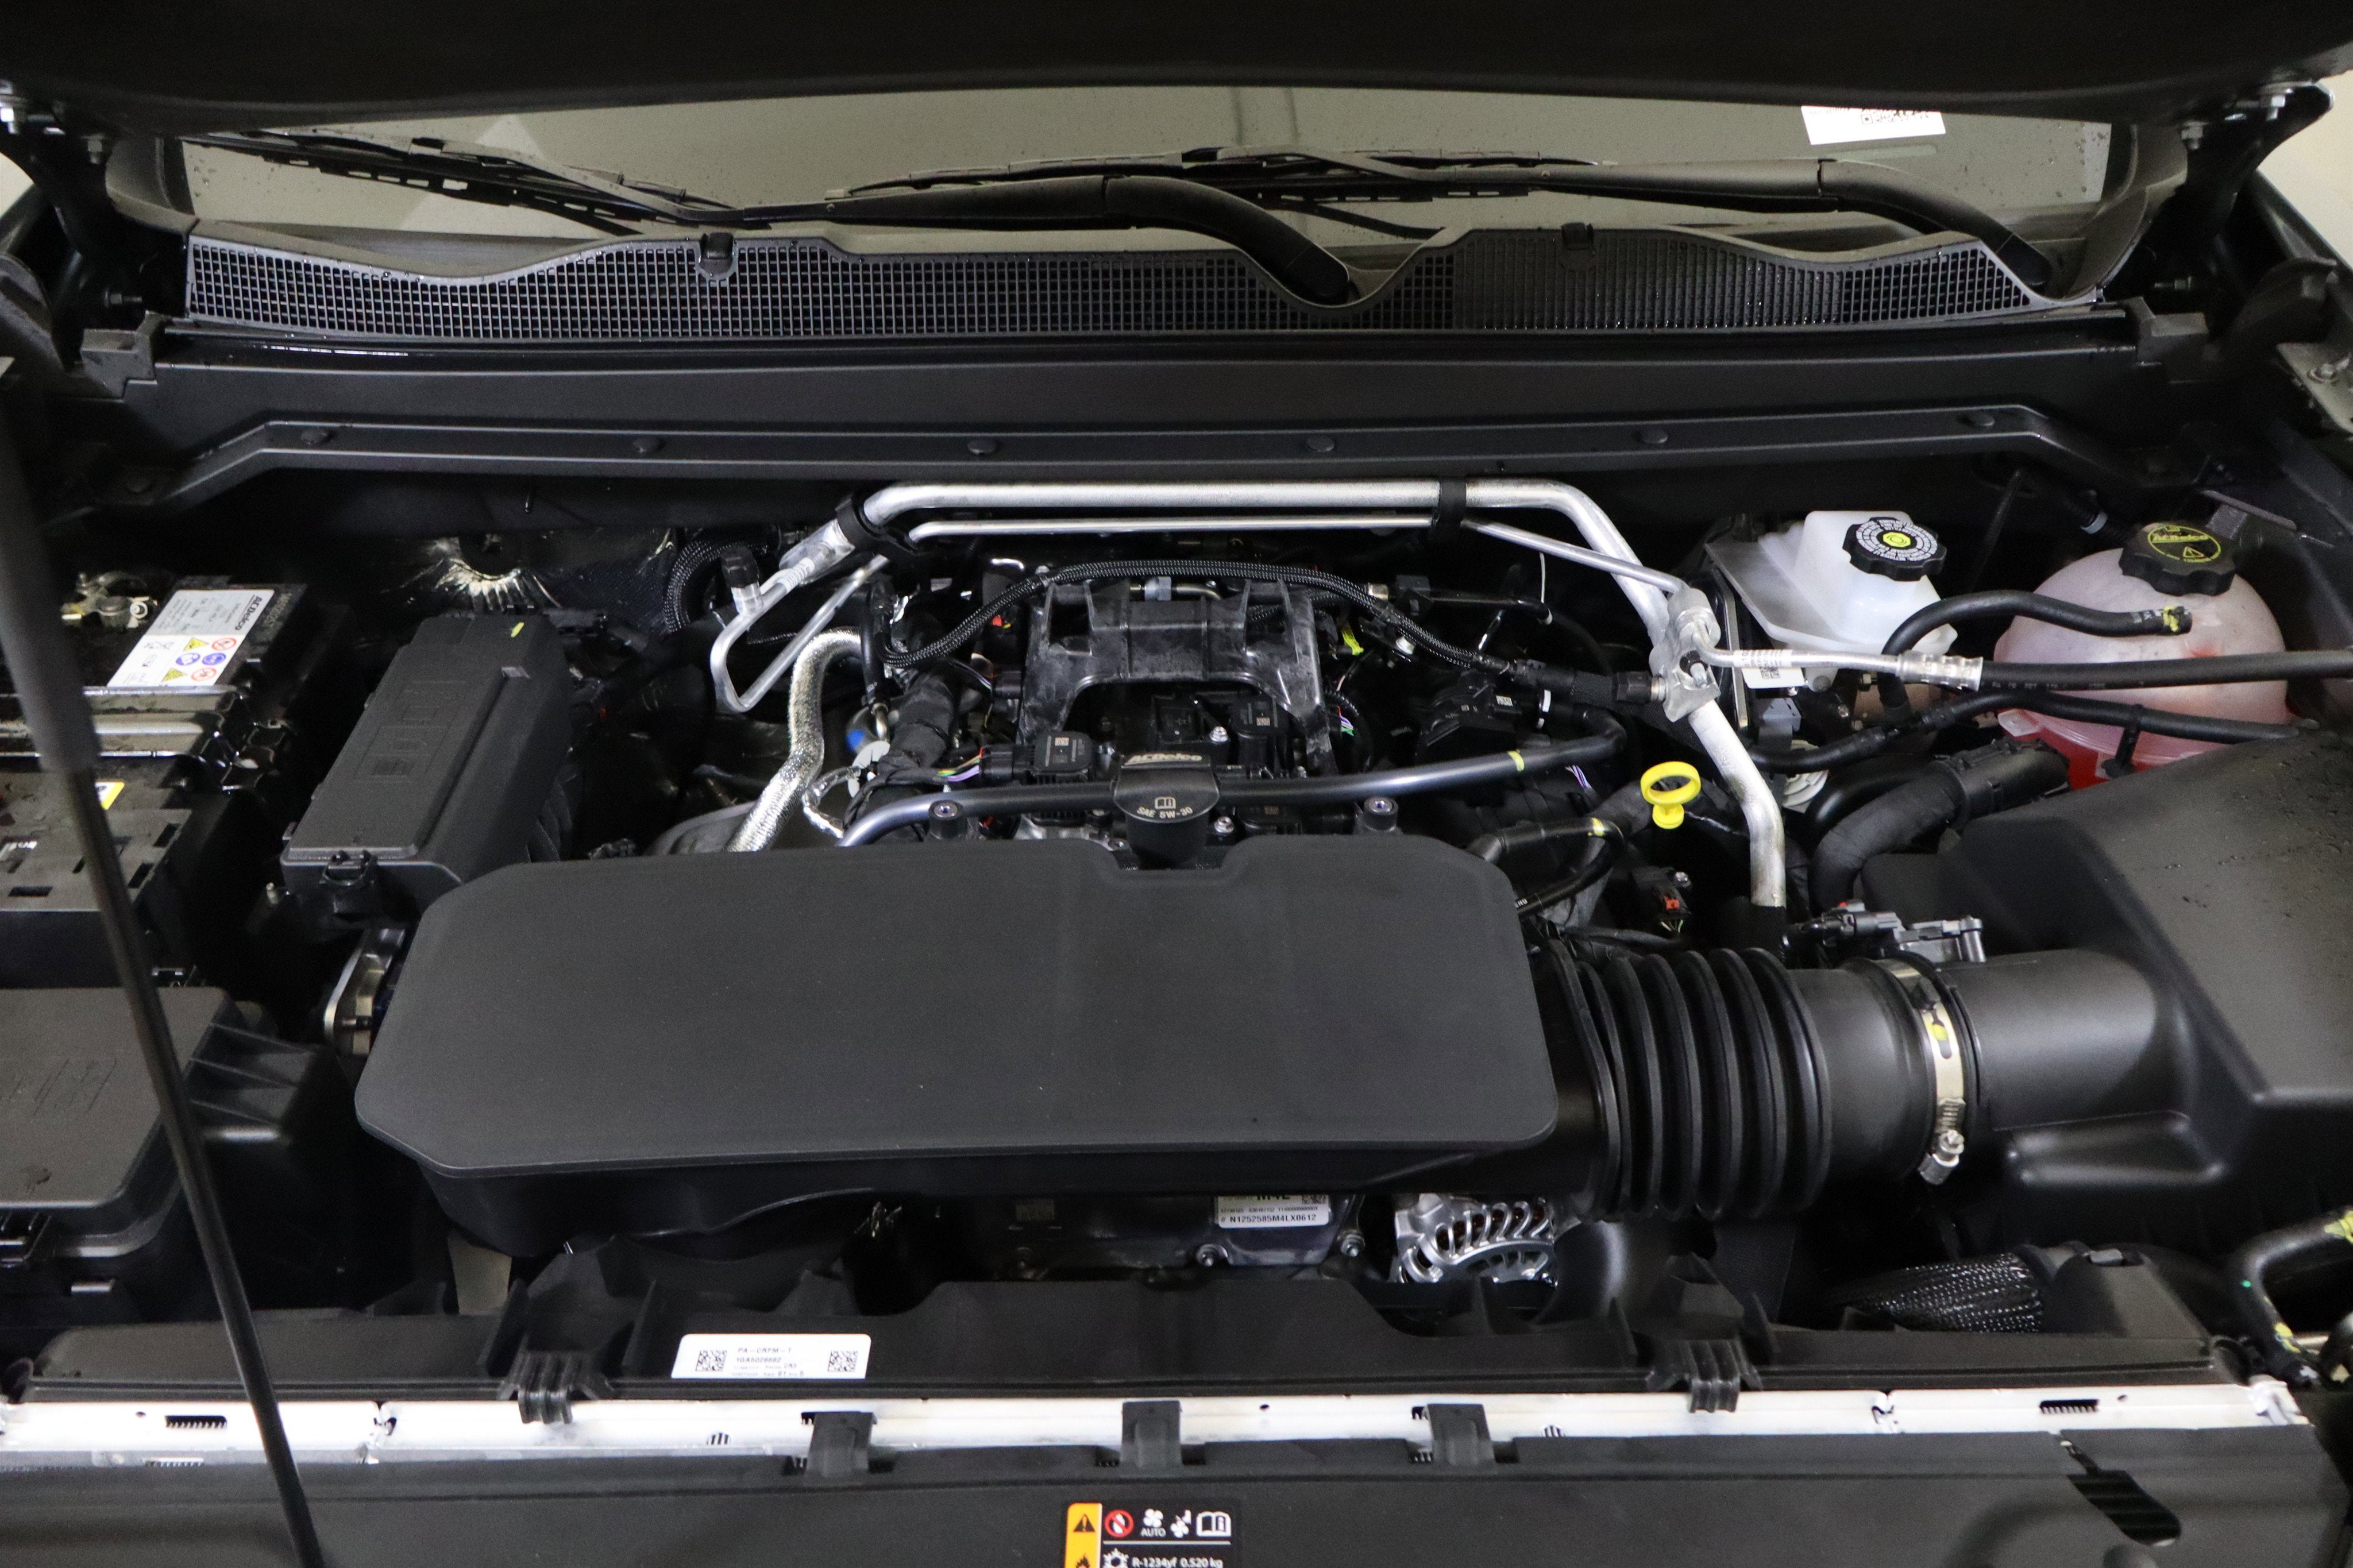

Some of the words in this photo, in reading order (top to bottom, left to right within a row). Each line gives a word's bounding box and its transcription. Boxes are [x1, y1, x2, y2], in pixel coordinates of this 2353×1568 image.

[235, 596, 260, 631] ACDelco
[1124, 752, 1203, 766] ACDelco
[1136, 806, 1156, 818] SAE
[1159, 806, 1193, 819] 5W-30
[1140, 1527, 1167, 1538] AUTO
[1132, 1556, 1178, 1568] R-1234yf
[1180, 1557, 1209, 1568] 0.520
[1209, 1556, 1223, 1568] kg
